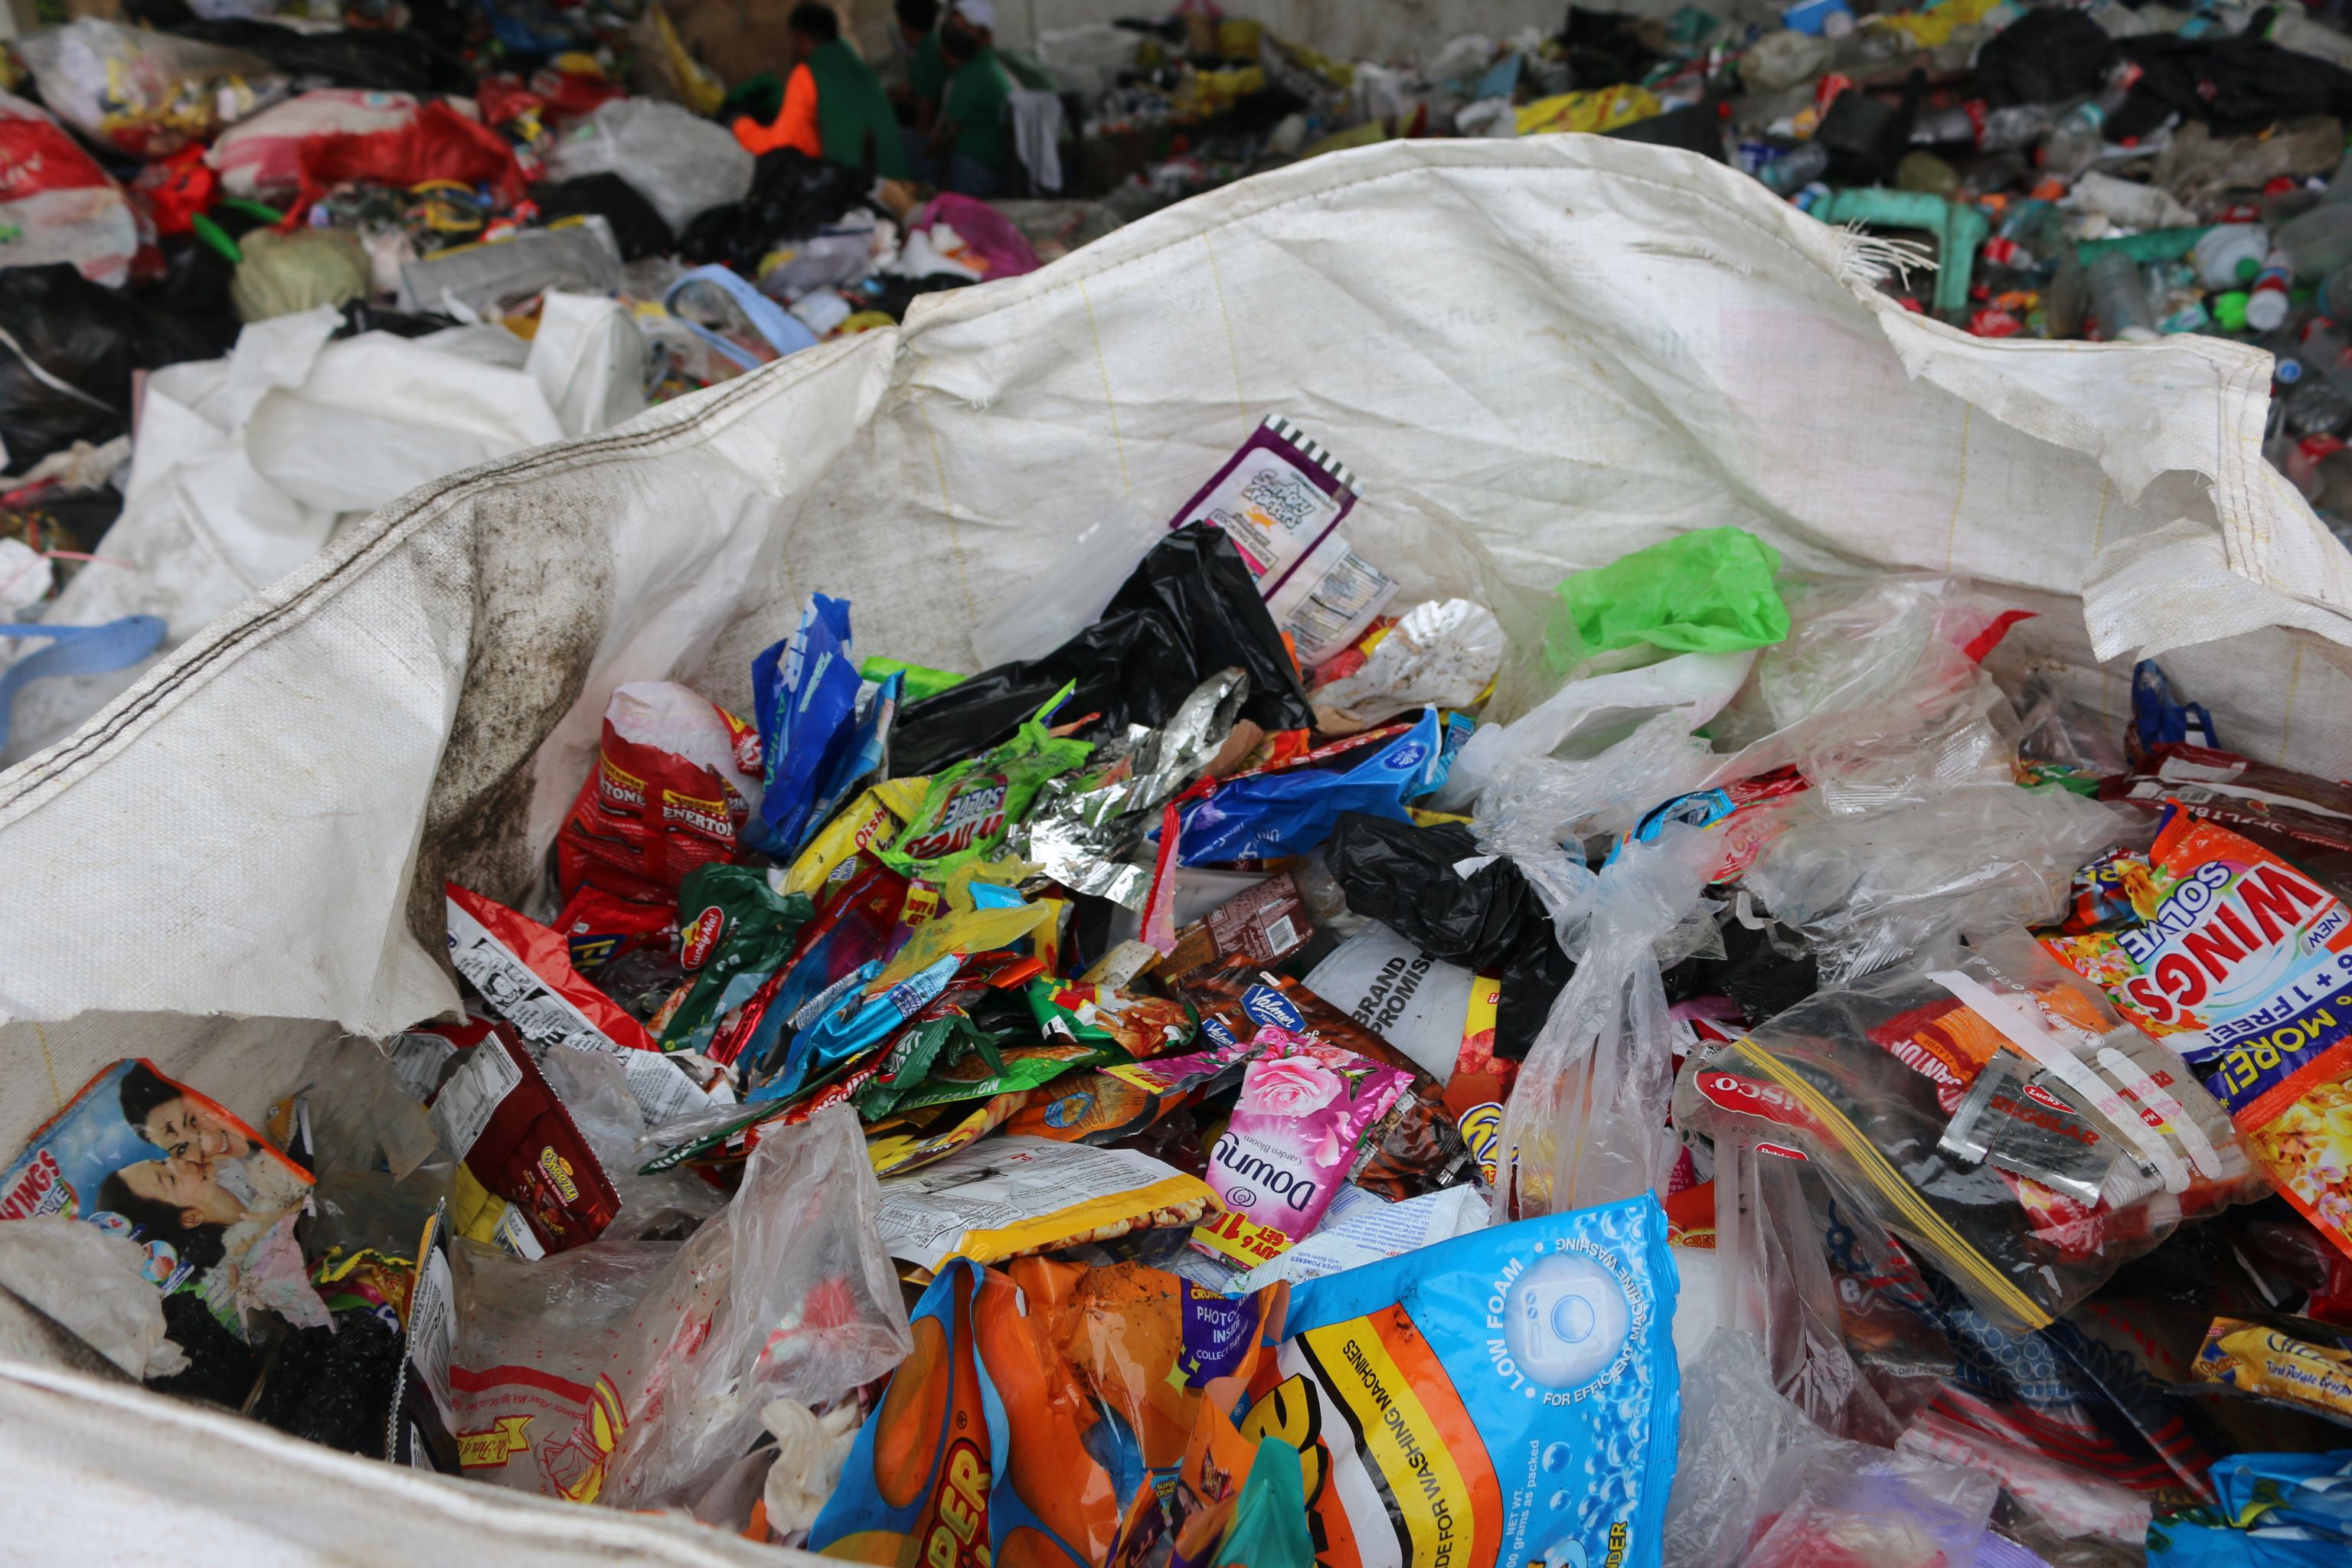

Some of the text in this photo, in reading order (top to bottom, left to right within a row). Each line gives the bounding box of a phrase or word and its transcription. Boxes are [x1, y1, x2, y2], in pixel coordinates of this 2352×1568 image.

[663, 806, 736, 837] ENERTON
[2115, 861, 2231, 965] SOLVE
[2307, 912, 2343, 949] NEW
[2125, 862, 2328, 1025] WINGS
[1250, 987, 1295, 1028] Valmer
[1351, 957, 1406, 1027] BRAND
[2292, 985, 2313, 1003] 1
[2204, 995, 2295, 1044] FREE!
[2220, 1008, 2337, 1096] MORE!
[1990, 1095, 2101, 1147] REGULAR
[1243, 1135, 1303, 1166] Garden Bloom
[541, 1146, 579, 1203] Cheezy
[1216, 1131, 1316, 1212] Downy
[35, 1185, 70, 1218] OLVE
[1240, 1235, 1255, 1249] 6
[1256, 1226, 1285, 1246] GET
[1290, 1256, 1343, 1272] SUPER POWERED
[1312, 1253, 1328, 1263] Super
[1556, 1238, 1619, 1275] WASHING
[1214, 1314, 1240, 1343] INSIDE
[1487, 1257, 1525, 1390] LOW FOAM
[1544, 1267, 1645, 1406] FOR EFFICIENT MACHINE
[1197, 1347, 1229, 1360] COLLECT
[1342, 1339, 1393, 1412] MACHINES
[1383, 1406, 1442, 1501] WASHING
[1527, 1439, 1539, 1488] packed
[1156, 1481, 1176, 1490] SUPER
[1156, 1488, 1175, 1497] CRUNC
[1524, 1491, 1534, 1507] as
[1432, 1498, 1454, 1542] FOR
[1507, 1488, 1524, 1536] NET WT.
[1514, 1510, 1529, 1549] grams
